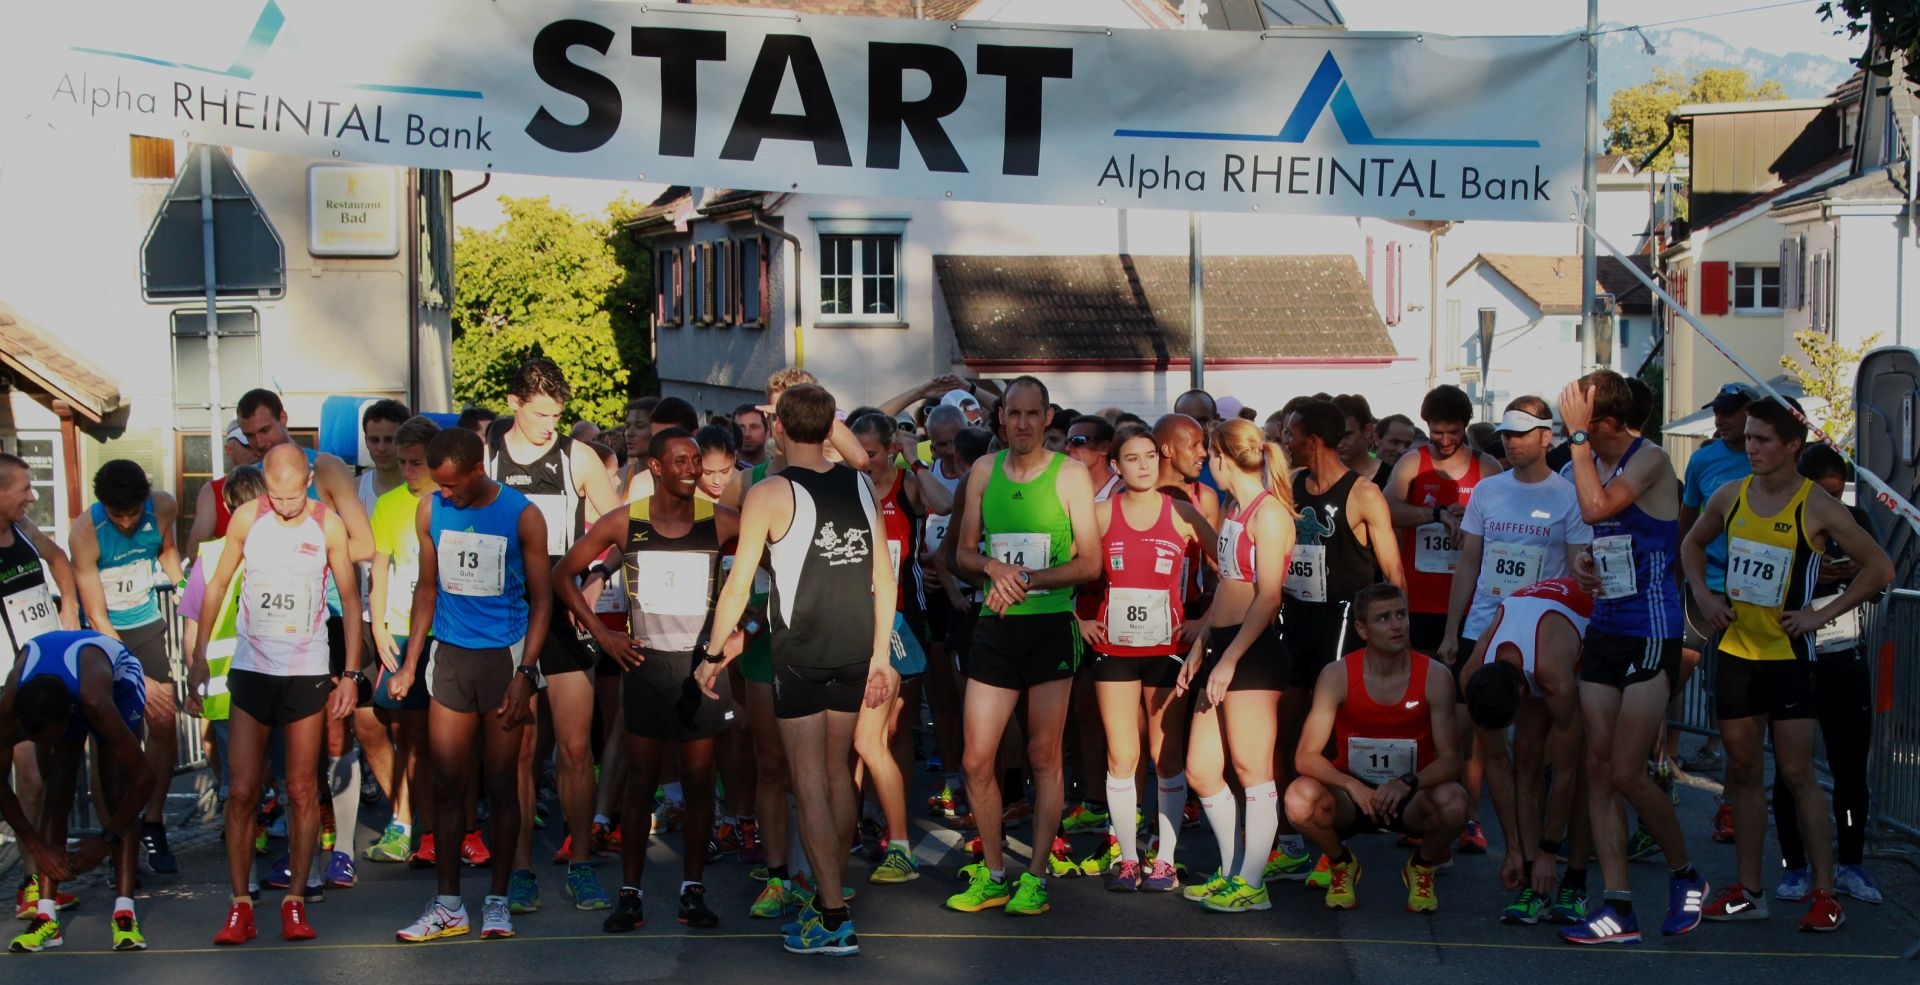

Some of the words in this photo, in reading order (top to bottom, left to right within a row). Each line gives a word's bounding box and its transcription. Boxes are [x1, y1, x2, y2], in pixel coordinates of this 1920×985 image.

[524, 19, 1073, 176] START
[52, 72, 155, 117] Alpha
[174, 82, 390, 144] RHEINTAL
[405, 114, 493, 151] Bank
[1097, 154, 1206, 199] Alpha
[1223, 154, 1446, 199] RHEINTAL
[1461, 165, 1551, 201] Bank
[326, 200, 382, 209] Restaurant
[340, 212, 368, 223] Bad
[1490, 521, 1551, 537] RAIFFEISEN
[1774, 522, 1793, 531] KTV
[457, 550, 480, 569] 13
[1003, 551, 1025, 567] 14
[1495, 558, 1526, 577] 836
[1733, 556, 1775, 580] 1178
[116, 580, 133, 593] 10
[663, 570, 676, 587] 3
[260, 592, 296, 611] 245
[1126, 605, 1148, 622] 85
[1368, 753, 1389, 769] 11
